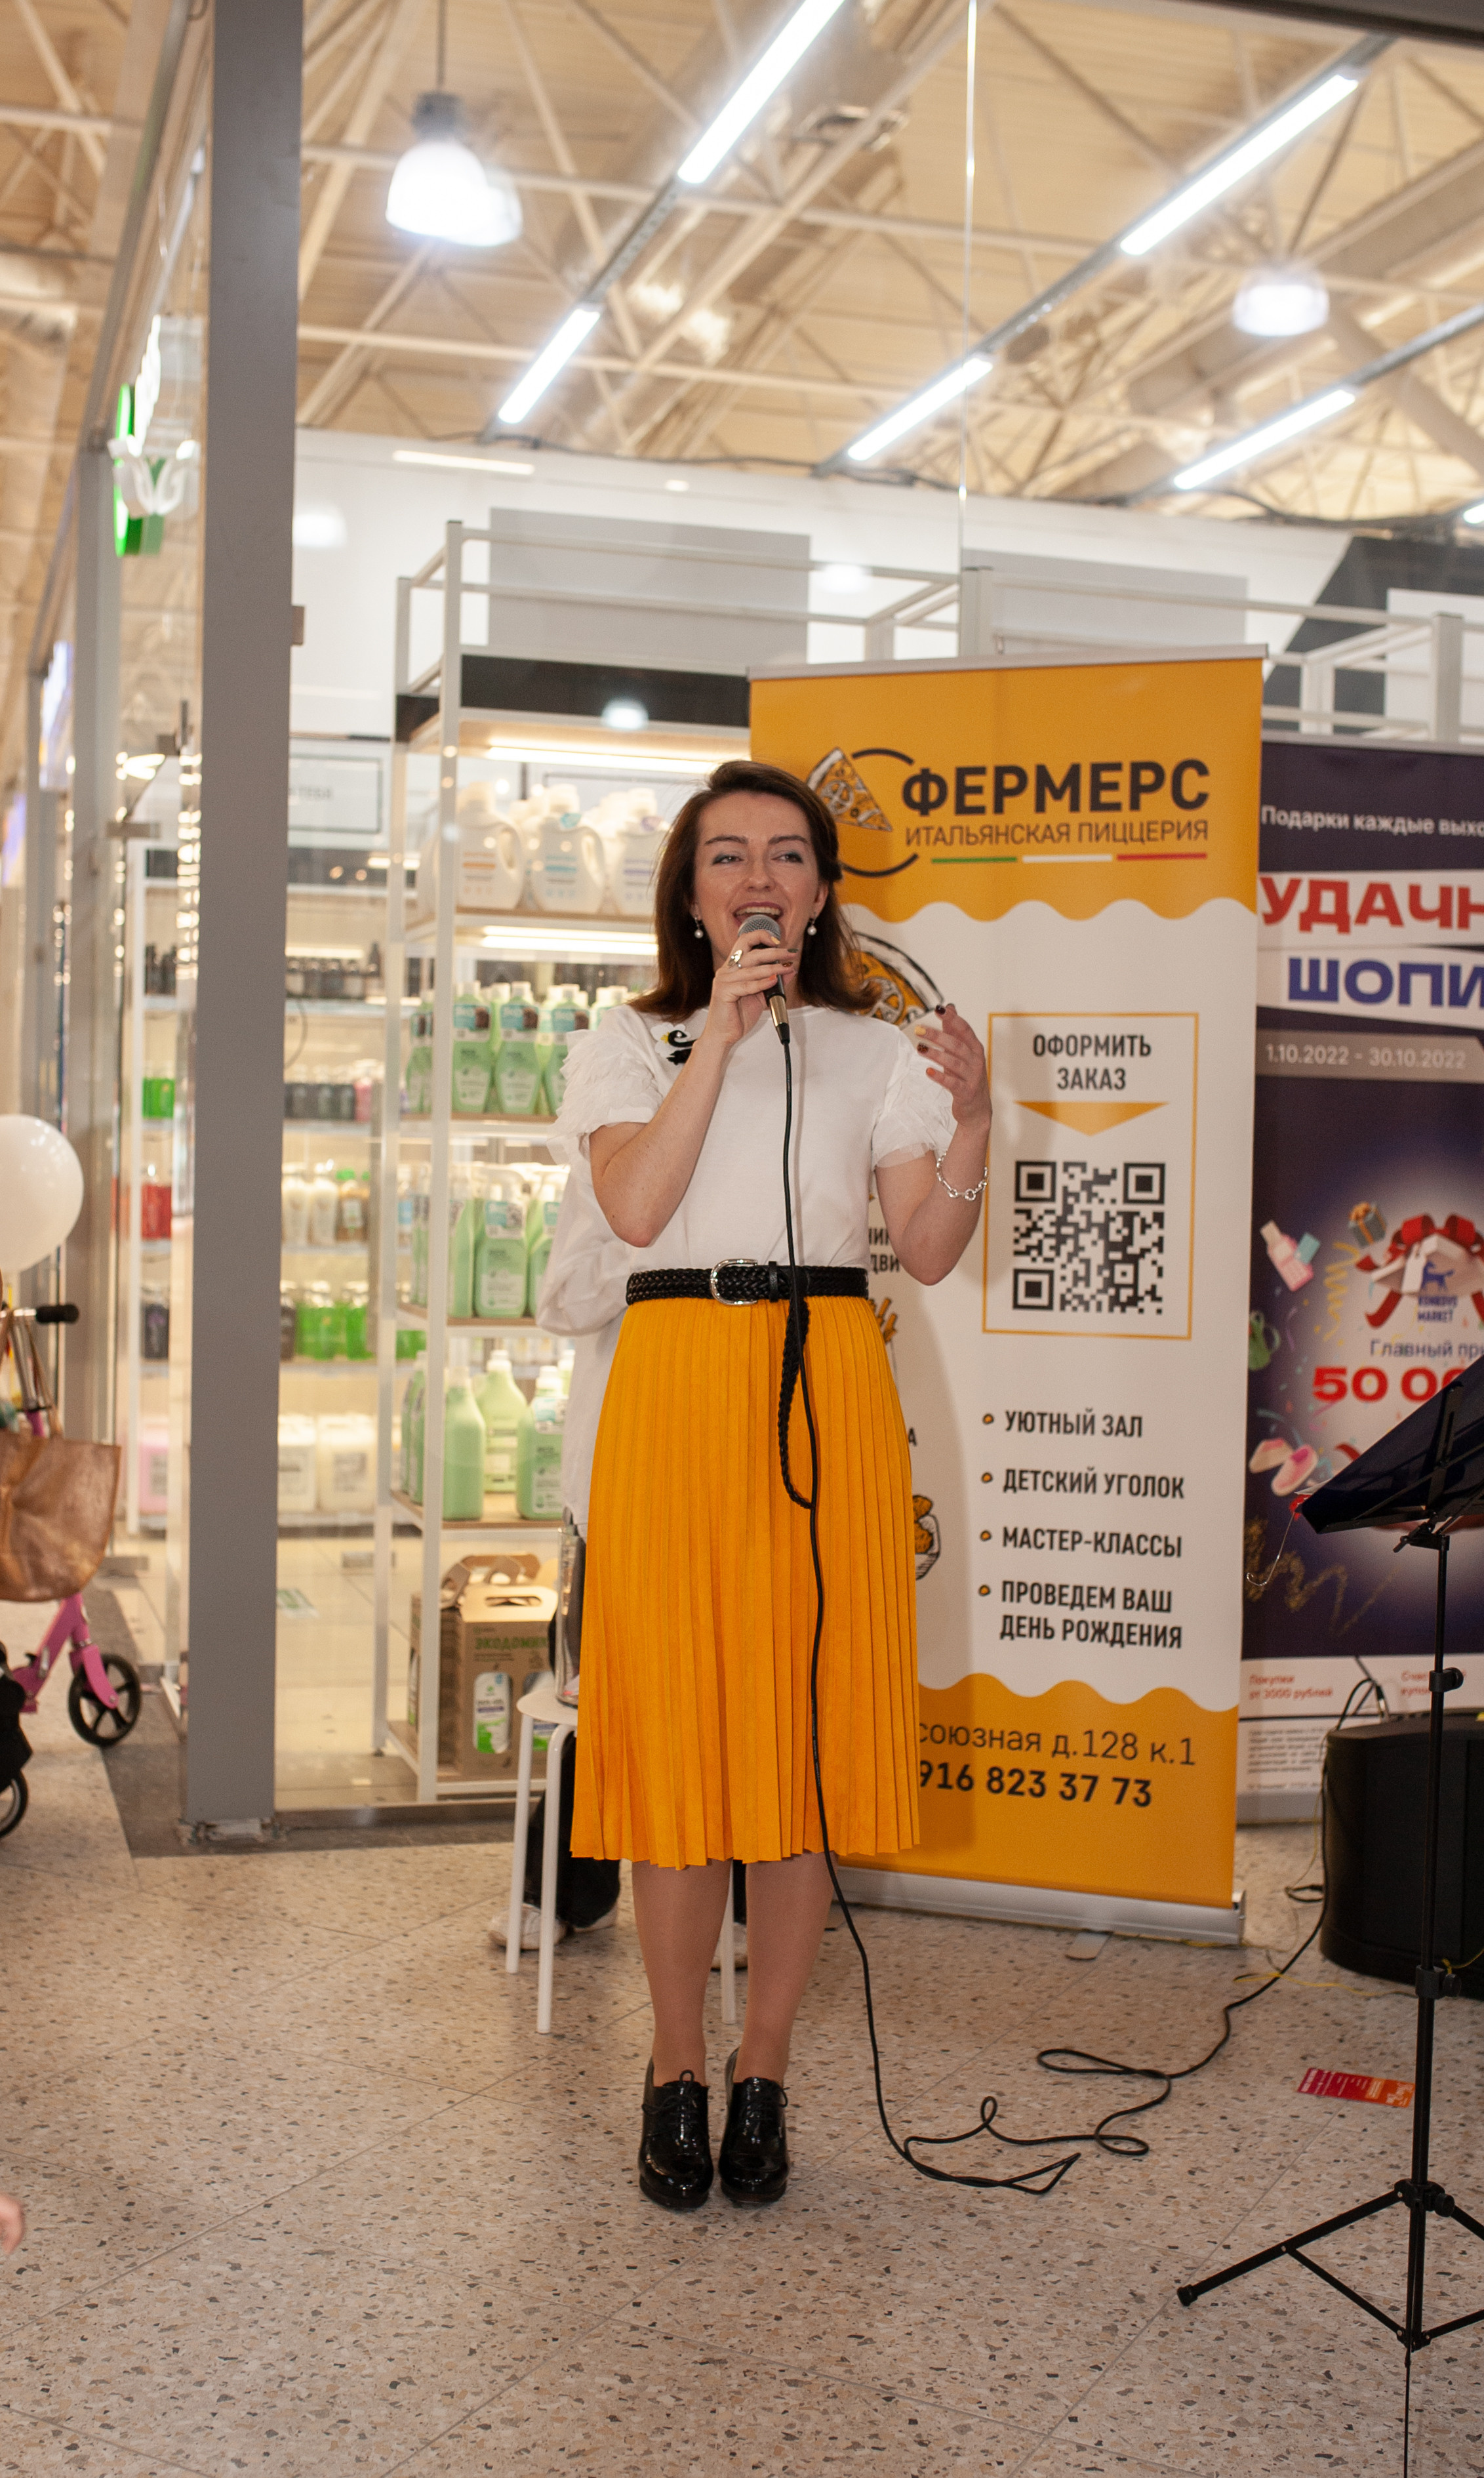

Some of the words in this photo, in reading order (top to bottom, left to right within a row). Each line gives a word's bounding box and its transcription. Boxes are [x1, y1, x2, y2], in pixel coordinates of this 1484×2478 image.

[902, 758, 1211, 815] ФЕРМЕРС
[905, 823, 1070, 847] ИТАЛЬЯНСКАЯ
[1077, 819, 1209, 845] ПИЦЦЕРИЯ
[1261, 805, 1349, 831] Подарки
[1353, 813, 1435, 836] каждые
[1287, 957, 1484, 1009] ШОПИ
[1033, 1034, 1152, 1057] ОФОРМИТЬ
[1266, 1043, 1349, 1065] 1.10.2022
[1369, 1046, 1466, 1069] 30.10.2022
[1056, 1067, 1127, 1091] ЗАКАЗ
[1371, 1338, 1453, 1357] Главный
[1312, 1366, 1388, 1403] 50
[1005, 1407, 1095, 1437] УЮТНЫЙ
[1102, 1415, 1143, 1438] ЗАЛ
[1003, 1467, 1097, 1494] ДЕТСКИЙ
[1104, 1474, 1184, 1499] УГОЛОК
[1003, 1527, 1182, 1558] МАСТЕР-КЛАССЫ
[1001, 1581, 1115, 1610] ПРОВЕДЕМ
[1123, 1587, 1173, 1613] ВАШ
[1000, 1615, 1054, 1641] ДЕНЬ
[1062, 1619, 1182, 1649] РОЖДЕНИЯ
[1051, 1730, 1138, 1760] д.128
[1150, 1737, 1195, 1766] к.1
[986, 1767, 1047, 1798] 823
[1058, 1773, 1099, 1802] 37
[1112, 1777, 1153, 1807] 73
